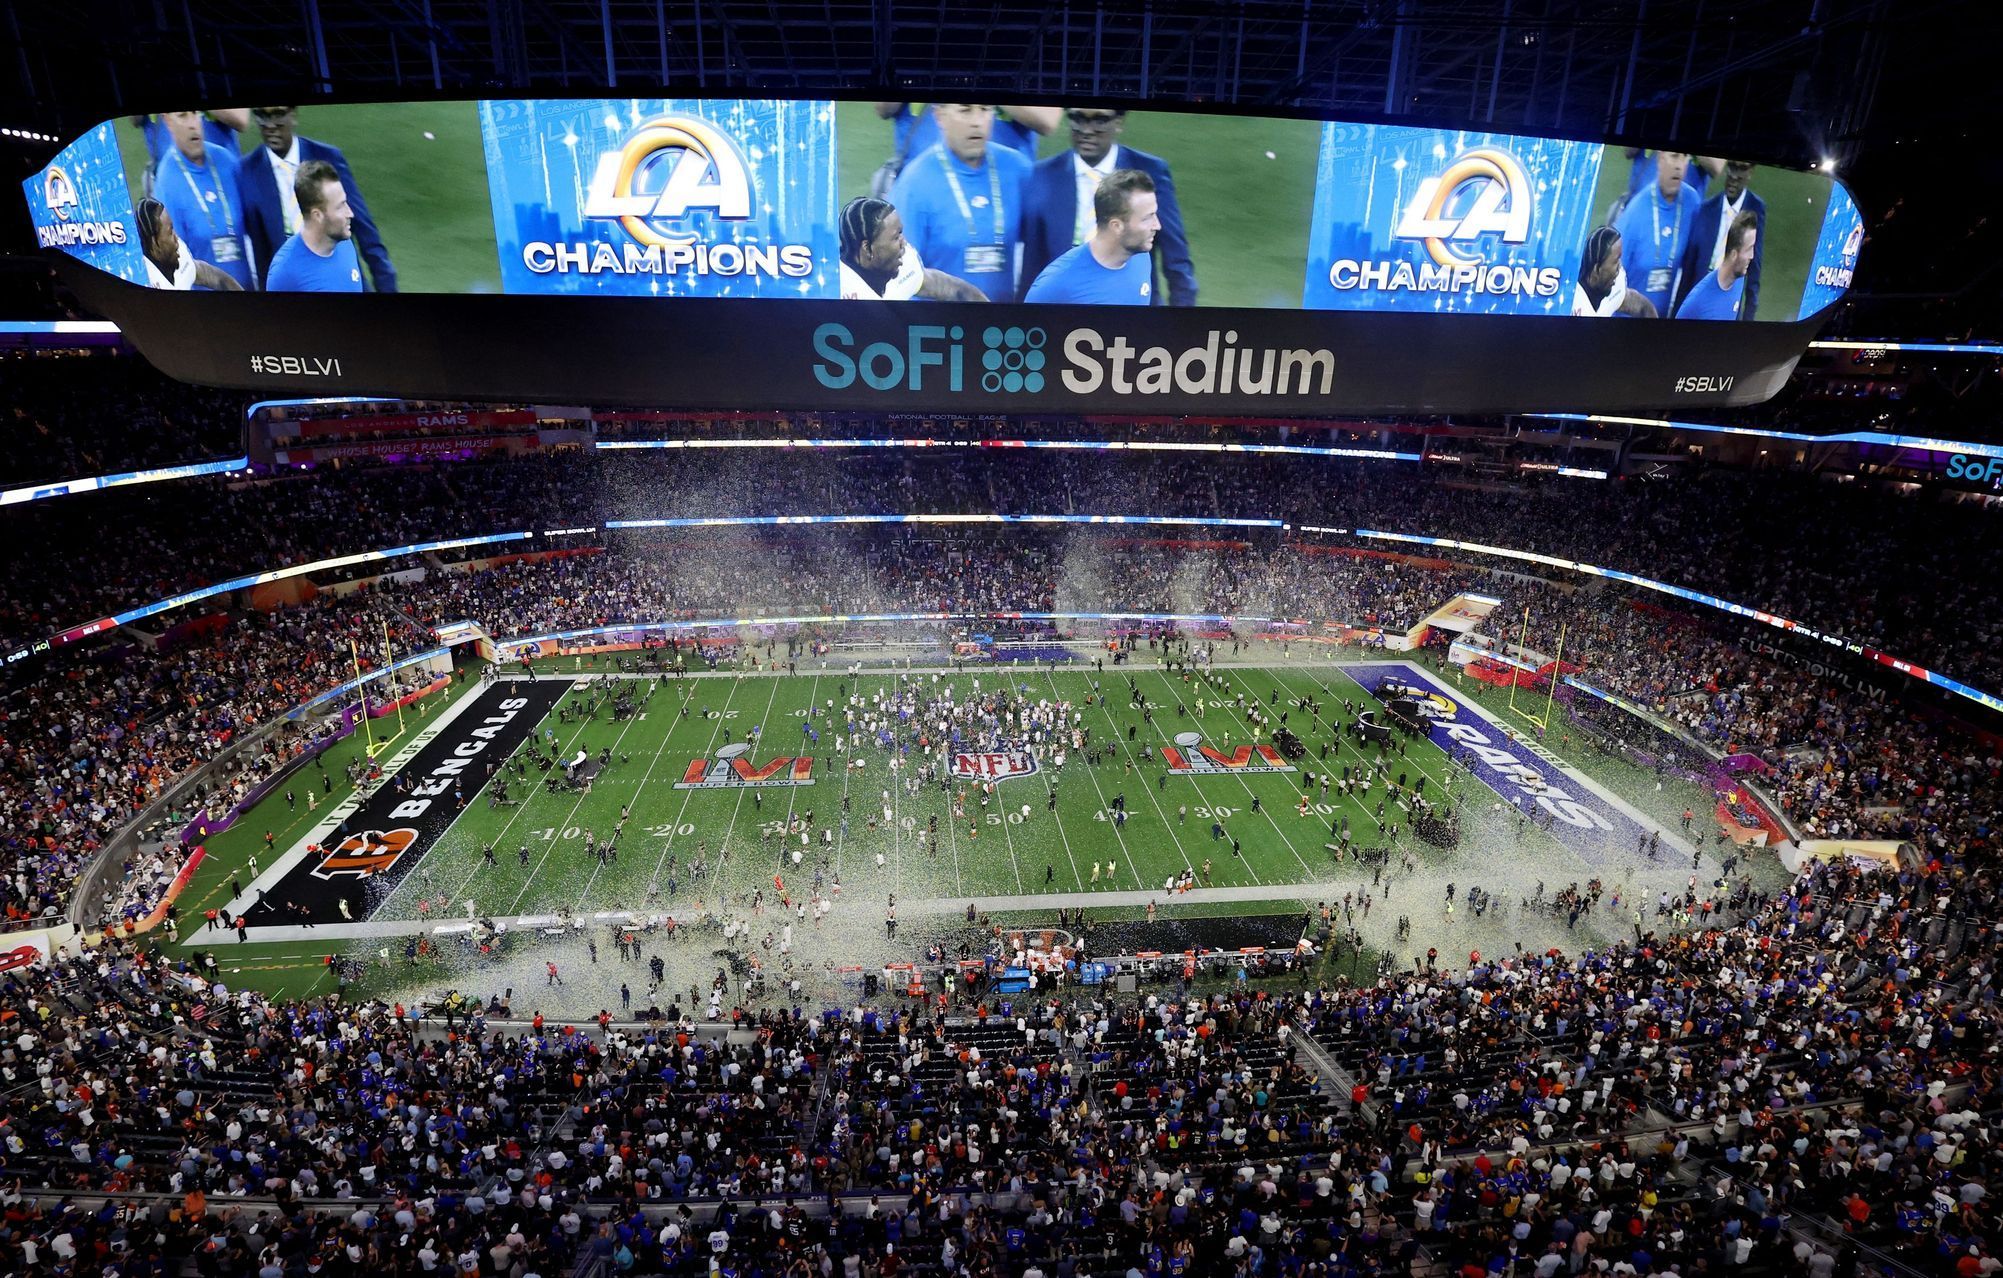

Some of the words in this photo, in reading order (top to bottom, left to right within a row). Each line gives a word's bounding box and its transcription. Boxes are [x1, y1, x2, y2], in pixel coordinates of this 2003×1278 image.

[38, 221, 127, 248] CHAMPIONS
[522, 241, 813, 277] CHAMPIONS
[1328, 258, 1562, 296] CHAMPIONS
[251, 354, 343, 378] #SBLVI
[812, 322, 965, 394] SoFi
[1060, 328, 1336, 397] Stadium
[1674, 375, 1734, 394] #SBLVI
[416, 414, 469, 428] RAMS
[888, 413, 928, 421] NATIONAL
[930, 413, 972, 421] FOOTBALL
[328, 446, 369, 458] WHOSE
[372, 442, 417, 455] HOUSE?
[421, 441, 452, 452] RAMS
[454, 438, 494, 449] HOUSE!
[1330, 448, 1397, 460] CHAMPIONS
[387, 697, 529, 820] BENGALS
[956, 752, 1029, 776] NFL
[321, 815, 345, 826] IT
[382, 757, 409, 775] ALL
[401, 744, 422, 756] OF
[415, 730, 438, 742] US
[986, 813, 1025, 825] 50
[1193, 806, 1233, 819] 30
[540, 826, 582, 841] 10
[652, 823, 696, 837] 20
[1107, 1235, 1114, 1245] 9
